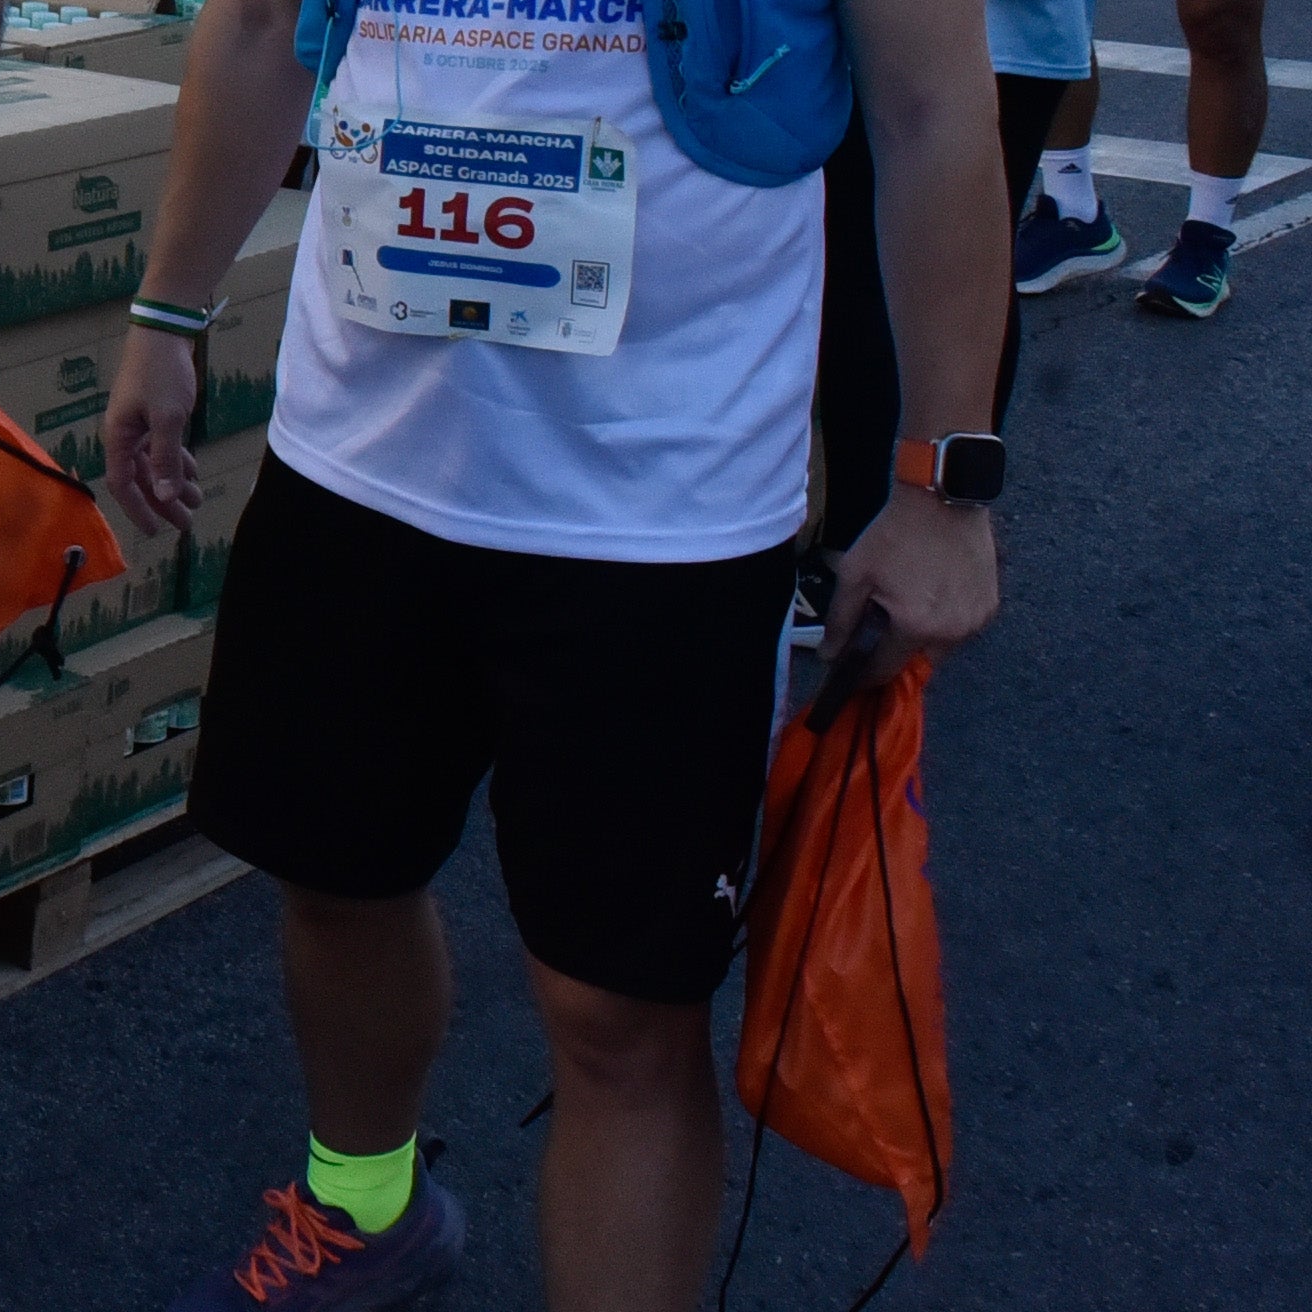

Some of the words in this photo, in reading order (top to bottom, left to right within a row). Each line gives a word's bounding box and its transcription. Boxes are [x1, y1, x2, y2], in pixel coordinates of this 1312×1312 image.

[452, 27, 535, 50] ASPACE
[436, 53, 506, 71] OCTUBRE
[509, 57, 550, 74] 2025
[390, 122, 576, 150] CARRERA-MARCHA
[422, 143, 529, 164] SOLIDARIA
[385, 158, 453, 178] ASPACE
[457, 166, 529, 186] Granada
[533, 173, 575, 190] 2025
[396, 187, 536, 250] 116
